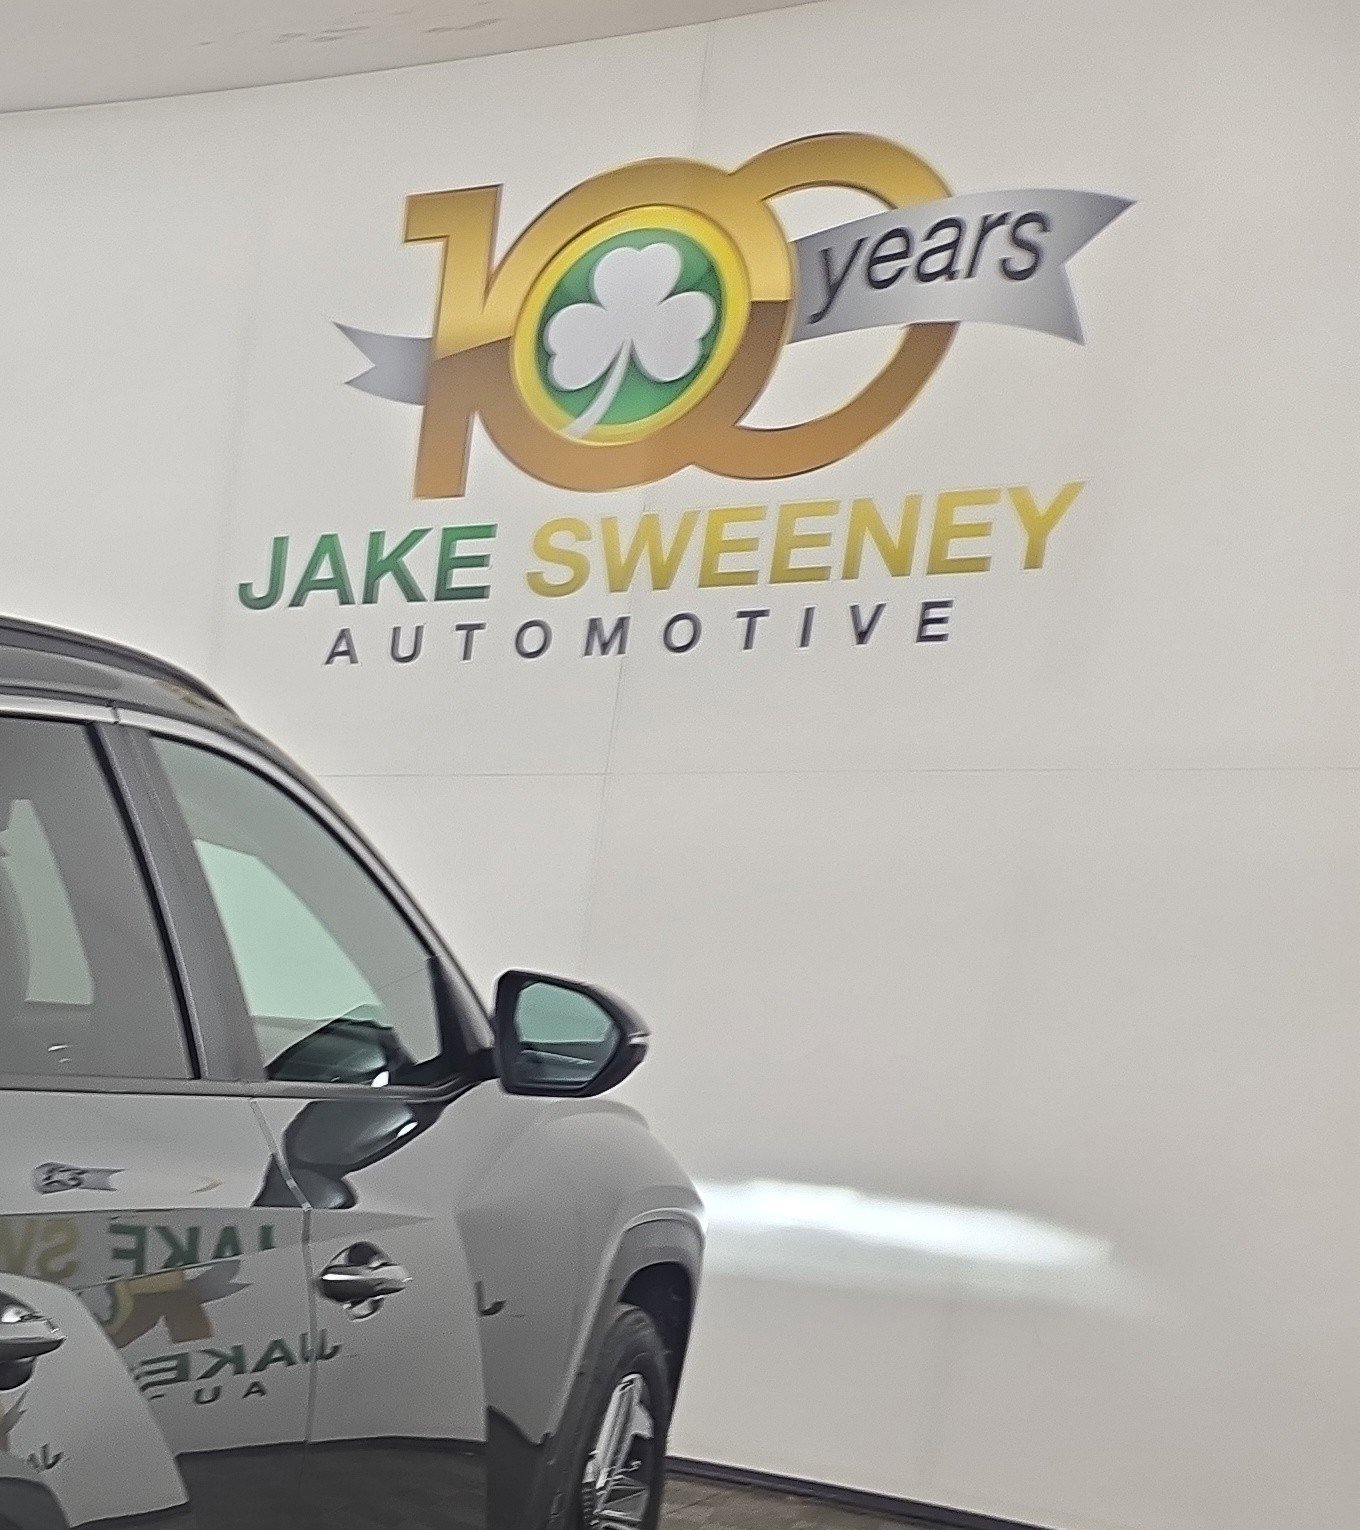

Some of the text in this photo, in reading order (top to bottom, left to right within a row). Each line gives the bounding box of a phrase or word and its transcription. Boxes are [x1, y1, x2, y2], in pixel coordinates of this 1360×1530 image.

[809, 208, 1051, 324] years
[238, 480, 1088, 611] JAKE SWEENEY
[325, 600, 954, 666] AUTOMOTIVE
